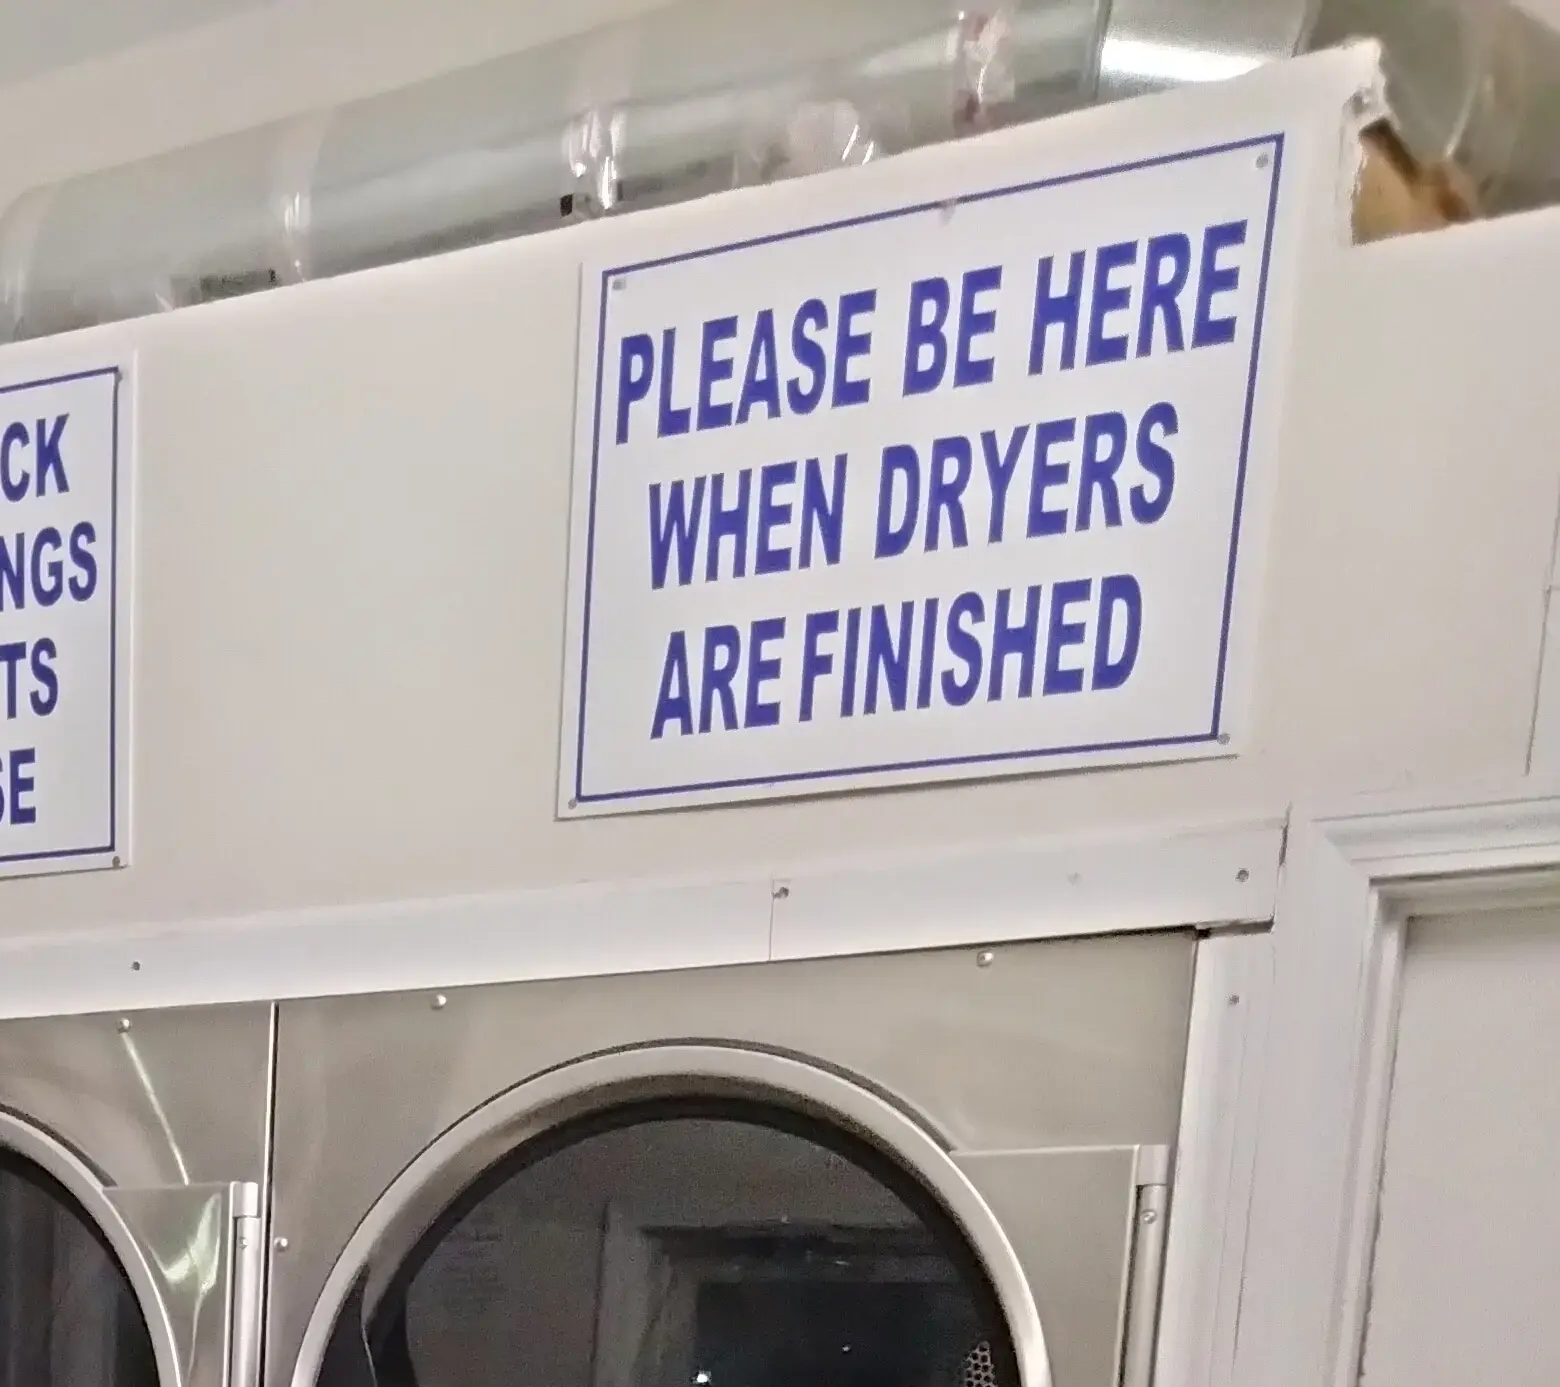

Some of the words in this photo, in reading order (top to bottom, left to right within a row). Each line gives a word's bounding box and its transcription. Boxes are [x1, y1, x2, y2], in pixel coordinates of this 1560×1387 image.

[615, 288, 878, 446] PLEASE
[902, 265, 1003, 398] BE
[1028, 218, 1249, 377] HERE
[648, 452, 849, 590] WHEN
[874, 401, 1179, 559] DRYERS
[650, 616, 787, 740] ARE
[798, 573, 1143, 724] FINISHED
